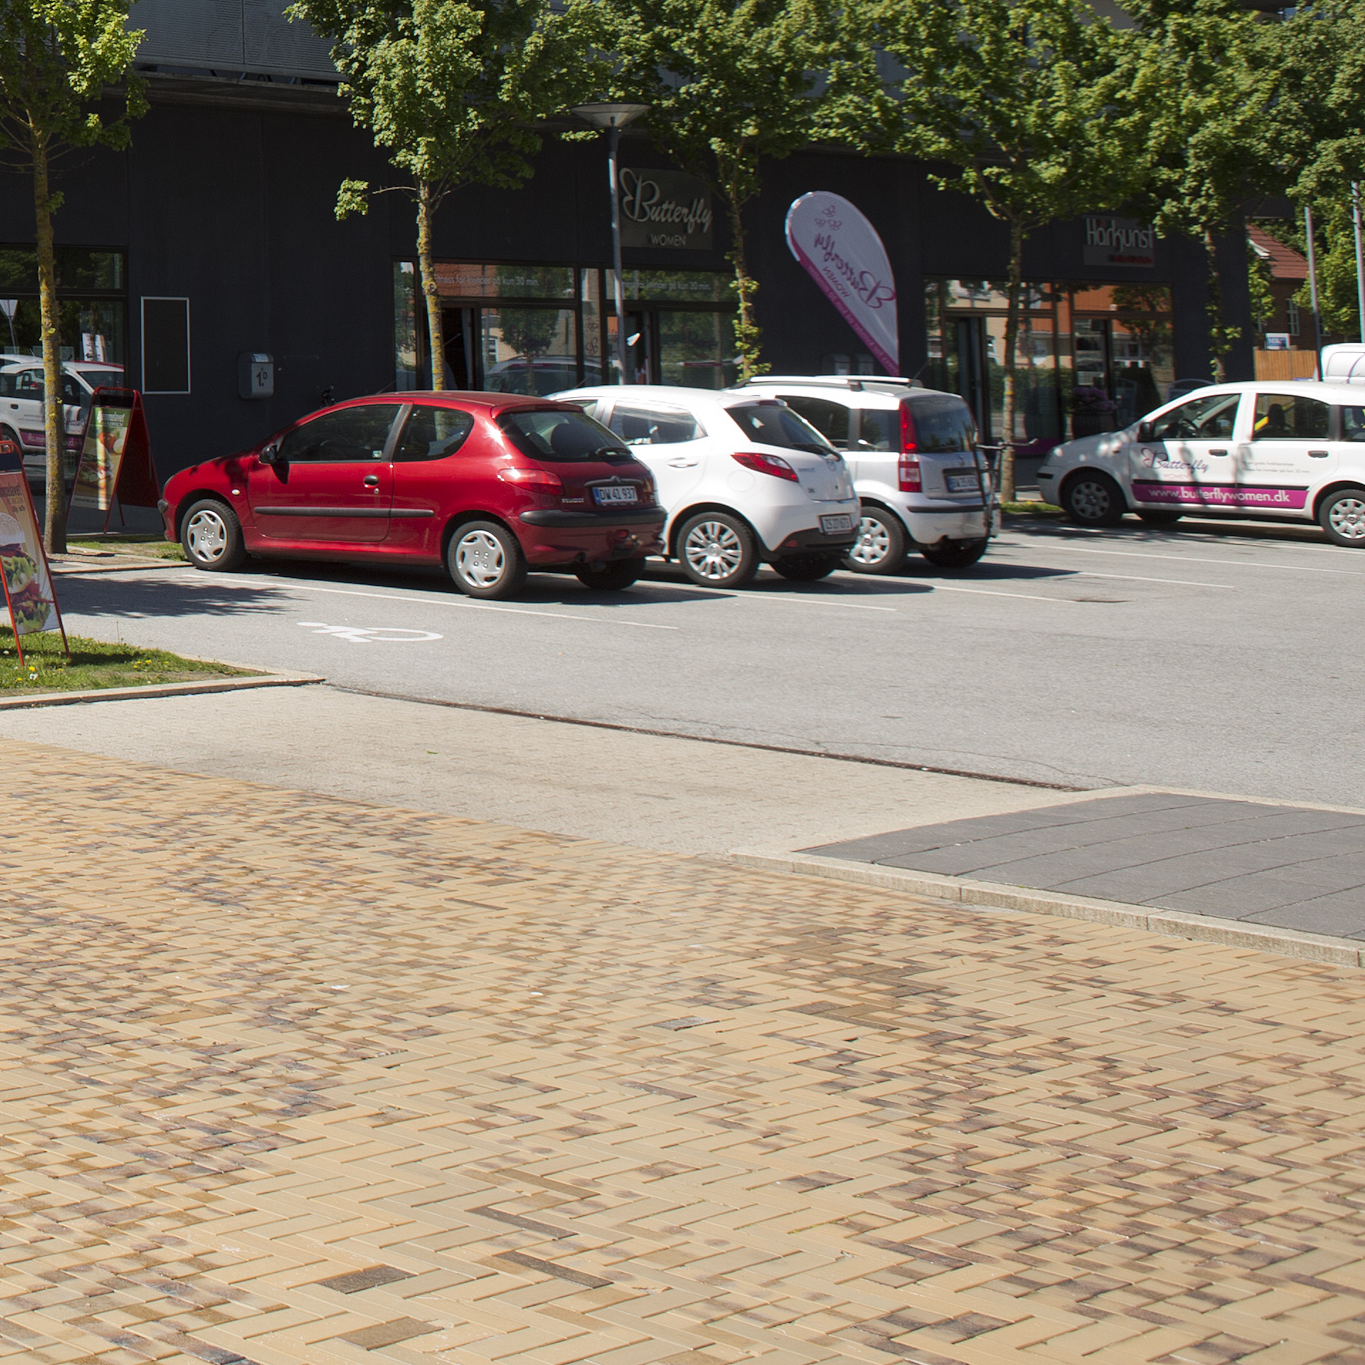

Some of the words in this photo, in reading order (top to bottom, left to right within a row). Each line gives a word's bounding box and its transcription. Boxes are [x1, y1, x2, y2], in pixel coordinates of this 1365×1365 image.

[618, 167, 714, 234] Butterfly
[651, 233, 687, 246] WOMEN
[1141, 447, 1210, 474] Butterfly
[1149, 487, 1291, 503] www.butterflywomen.dk
